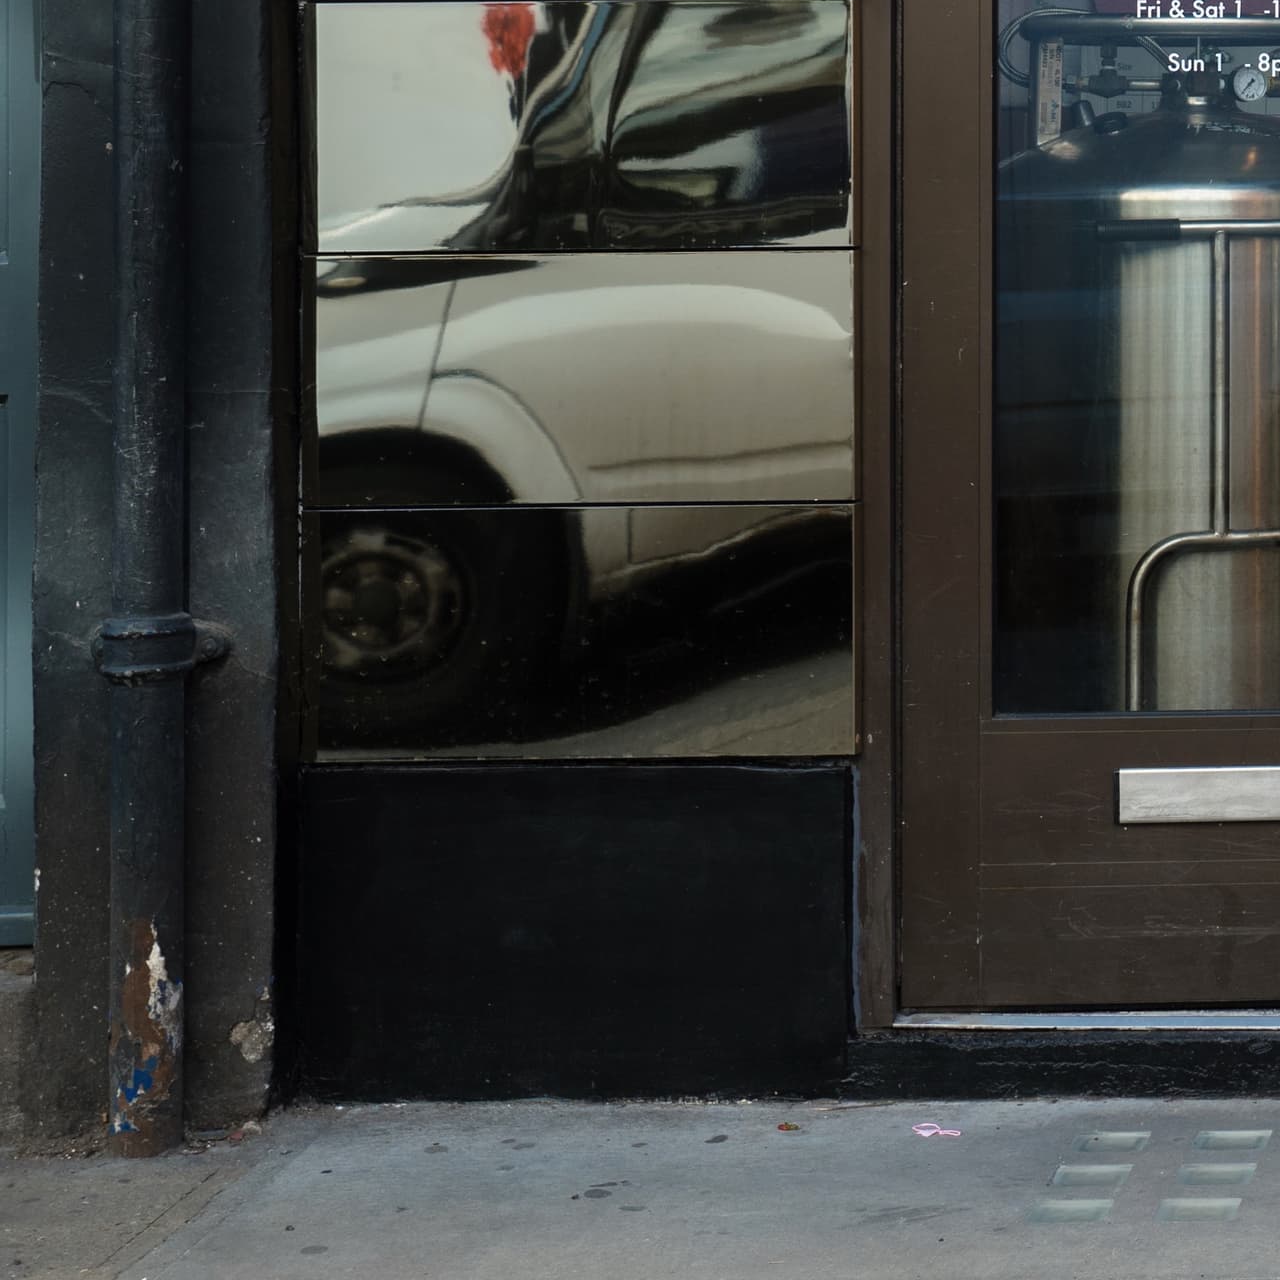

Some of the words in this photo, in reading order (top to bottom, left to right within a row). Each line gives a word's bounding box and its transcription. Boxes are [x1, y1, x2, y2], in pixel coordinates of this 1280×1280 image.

[1137, 0, 1160, 17] Fri
[1170, 0, 1184, 17] &
[1192, 0, 1226, 18] Sat
[1234, 0, 1242, 18] 1
[1169, 54, 1204, 71] Sun
[1215, 53, 1222, 72] 1
